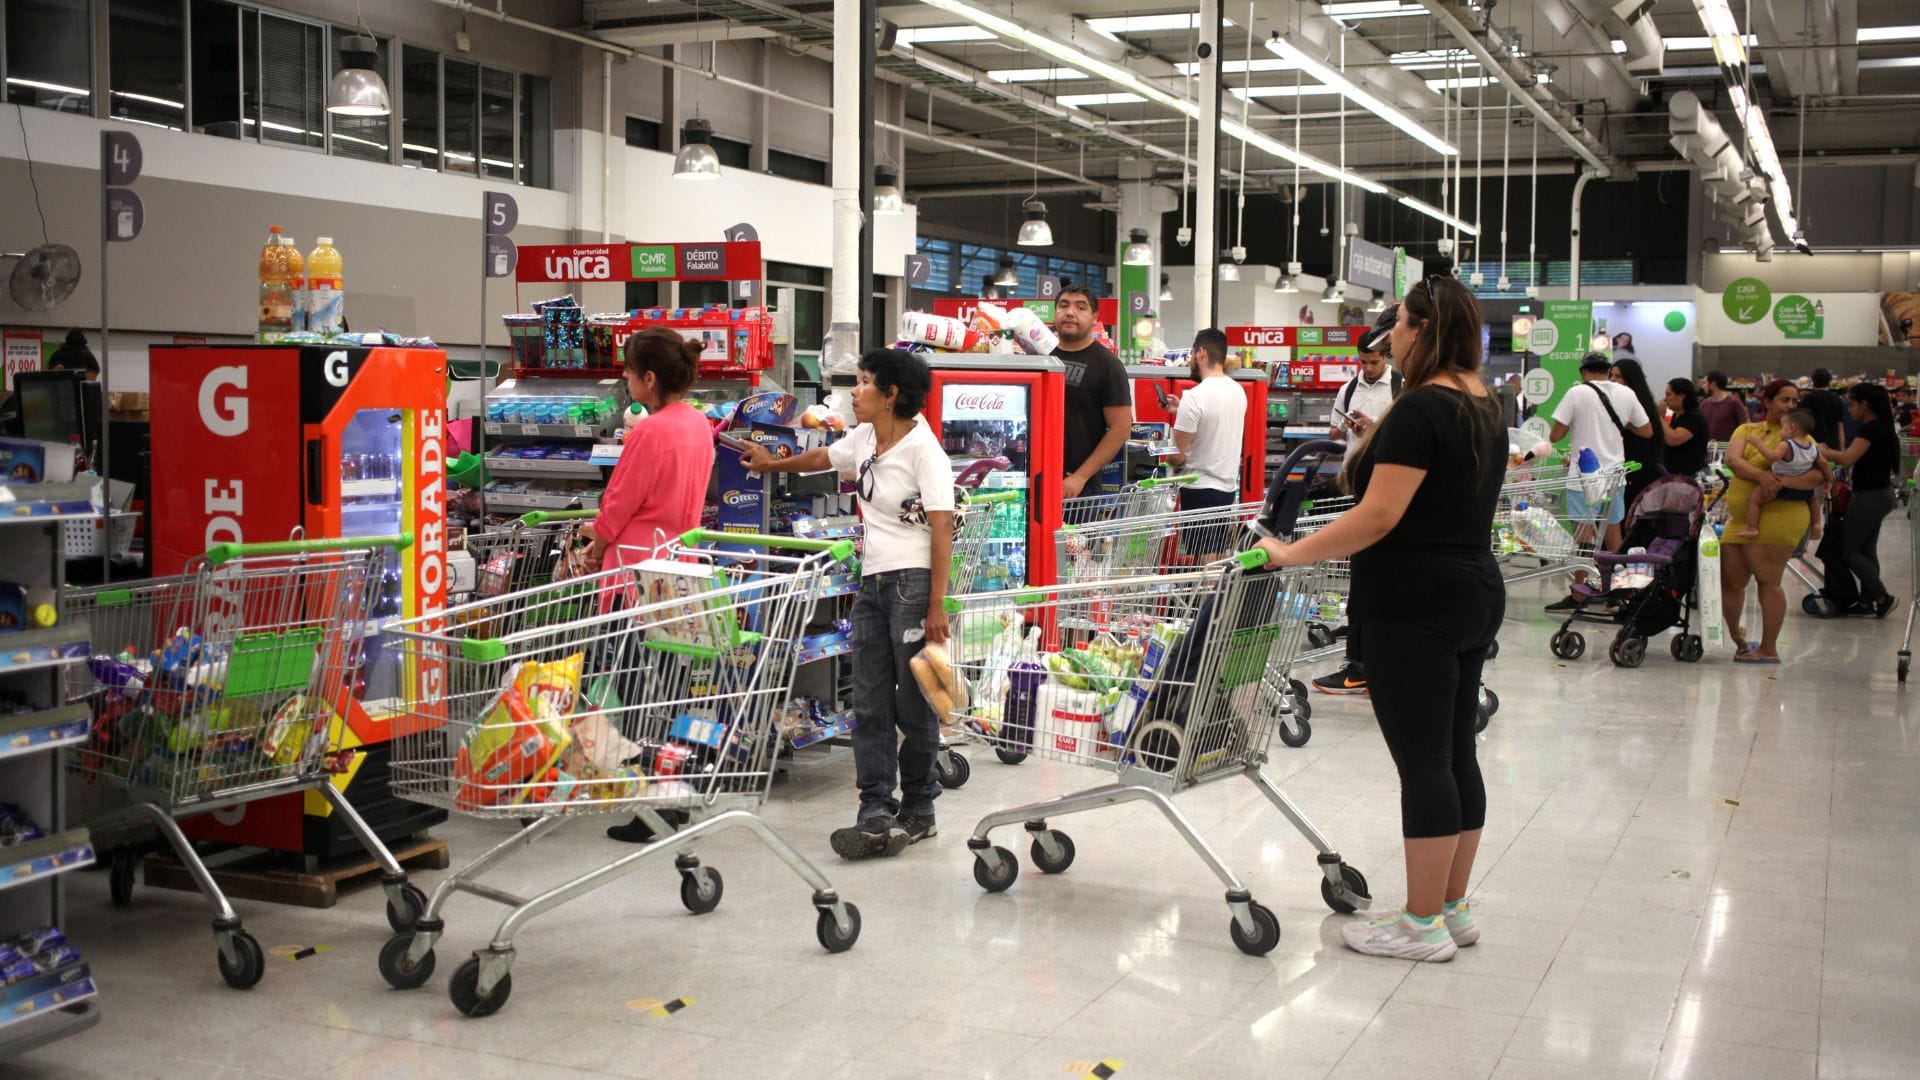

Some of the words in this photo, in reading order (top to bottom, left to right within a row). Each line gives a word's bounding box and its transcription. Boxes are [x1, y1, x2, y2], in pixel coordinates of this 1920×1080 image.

[113, 143, 130, 173] 4
[492, 202, 506, 226] 5
[573, 248, 609, 257] Oportunidad
[639, 252, 667, 265] CMR
[686, 249, 719, 261] DÉBITO
[545, 249, 610, 279] única
[686, 261, 719, 271] Falabella
[912, 262, 922, 278] 7
[1042, 281, 1053, 296] 8
[1134, 297, 1144, 311] 9
[1244, 327, 1284, 344] única
[1575, 333, 1585, 352] 1
[324, 351, 349, 387] G
[198, 365, 249, 437] G
[746, 399, 769, 415] OREO
[955, 392, 1006, 410] Coca-Cola
[729, 494, 760, 505] OREO
[420, 408, 444, 708] GATORADE
